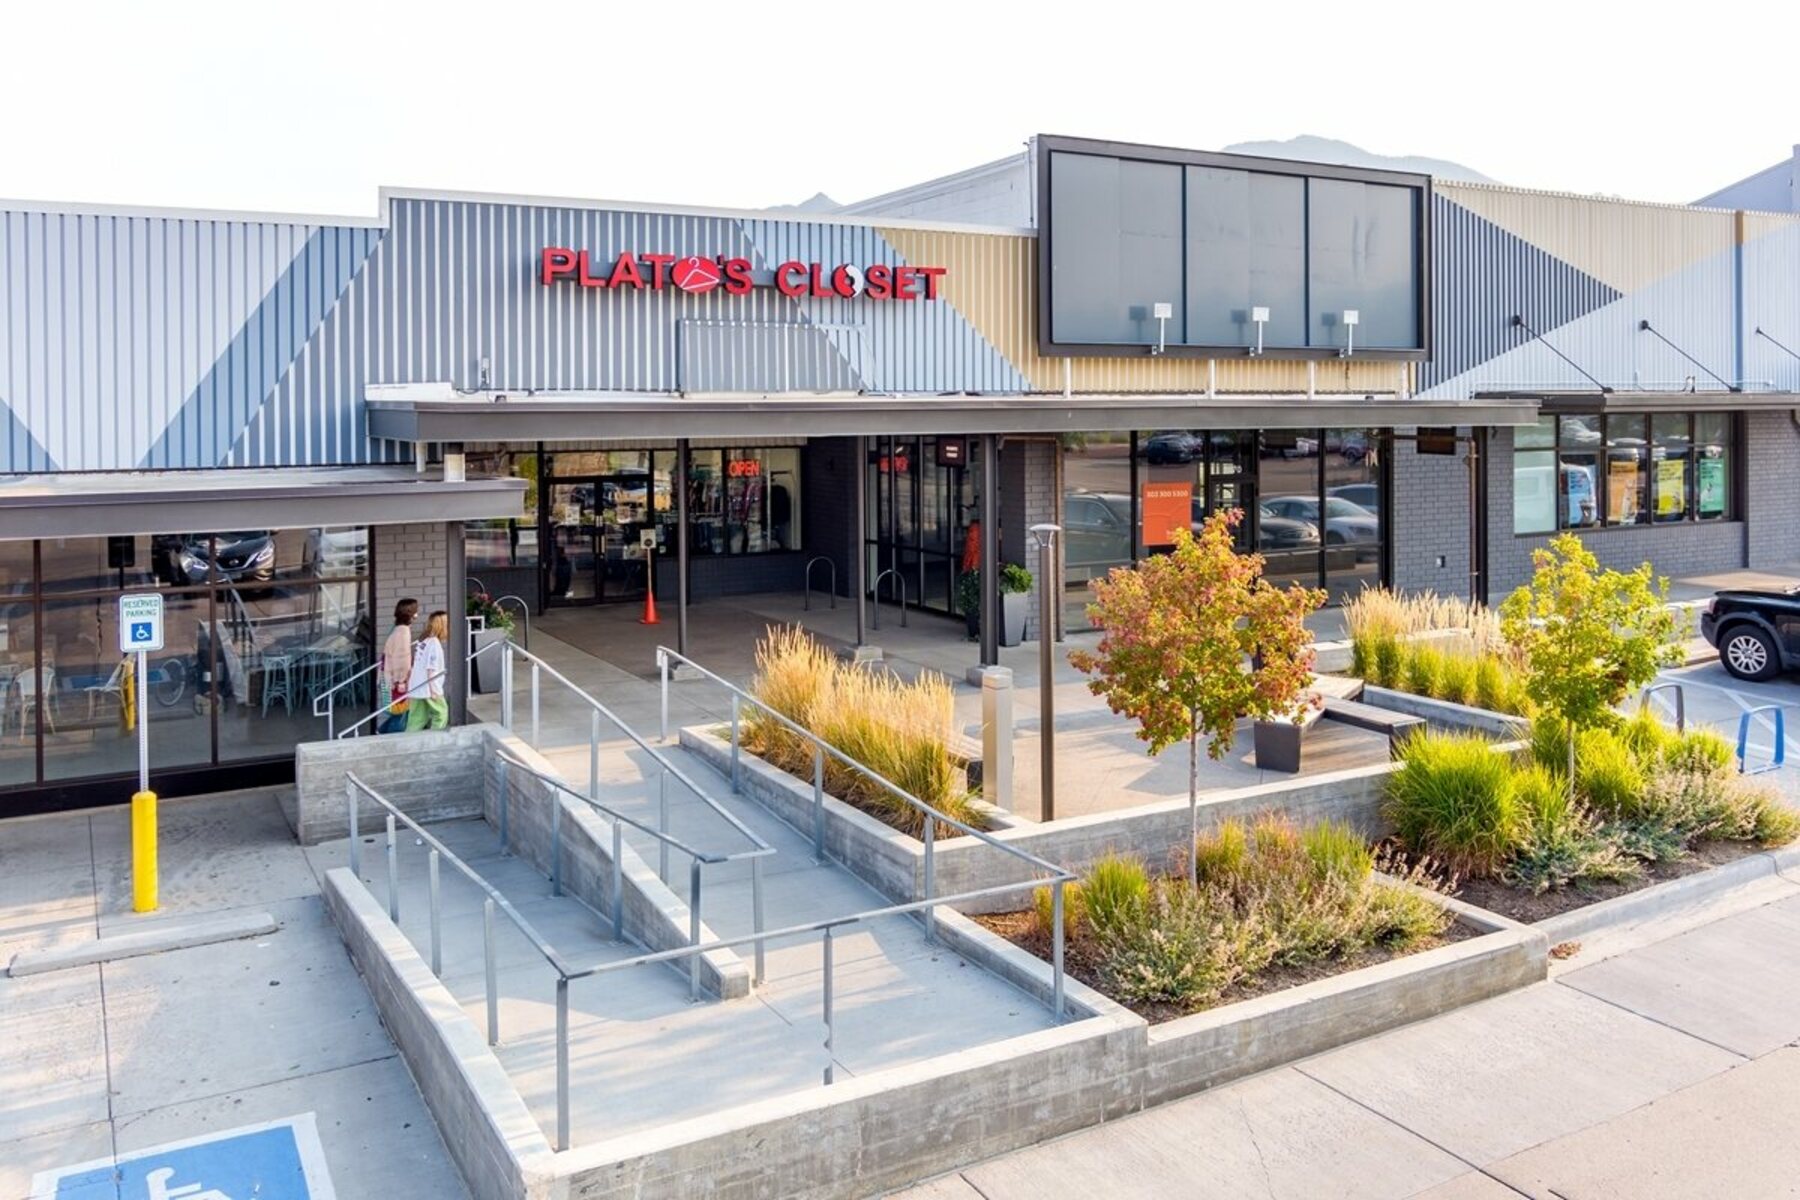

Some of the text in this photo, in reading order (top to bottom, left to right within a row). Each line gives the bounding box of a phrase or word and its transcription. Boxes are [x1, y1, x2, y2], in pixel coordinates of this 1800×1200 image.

[541, 247, 948, 300] PLATO'S CLOSET
[729, 461, 760, 477] OPEN
[123, 599, 158, 609] RESERVED
[125, 608, 157, 617] PARKING
